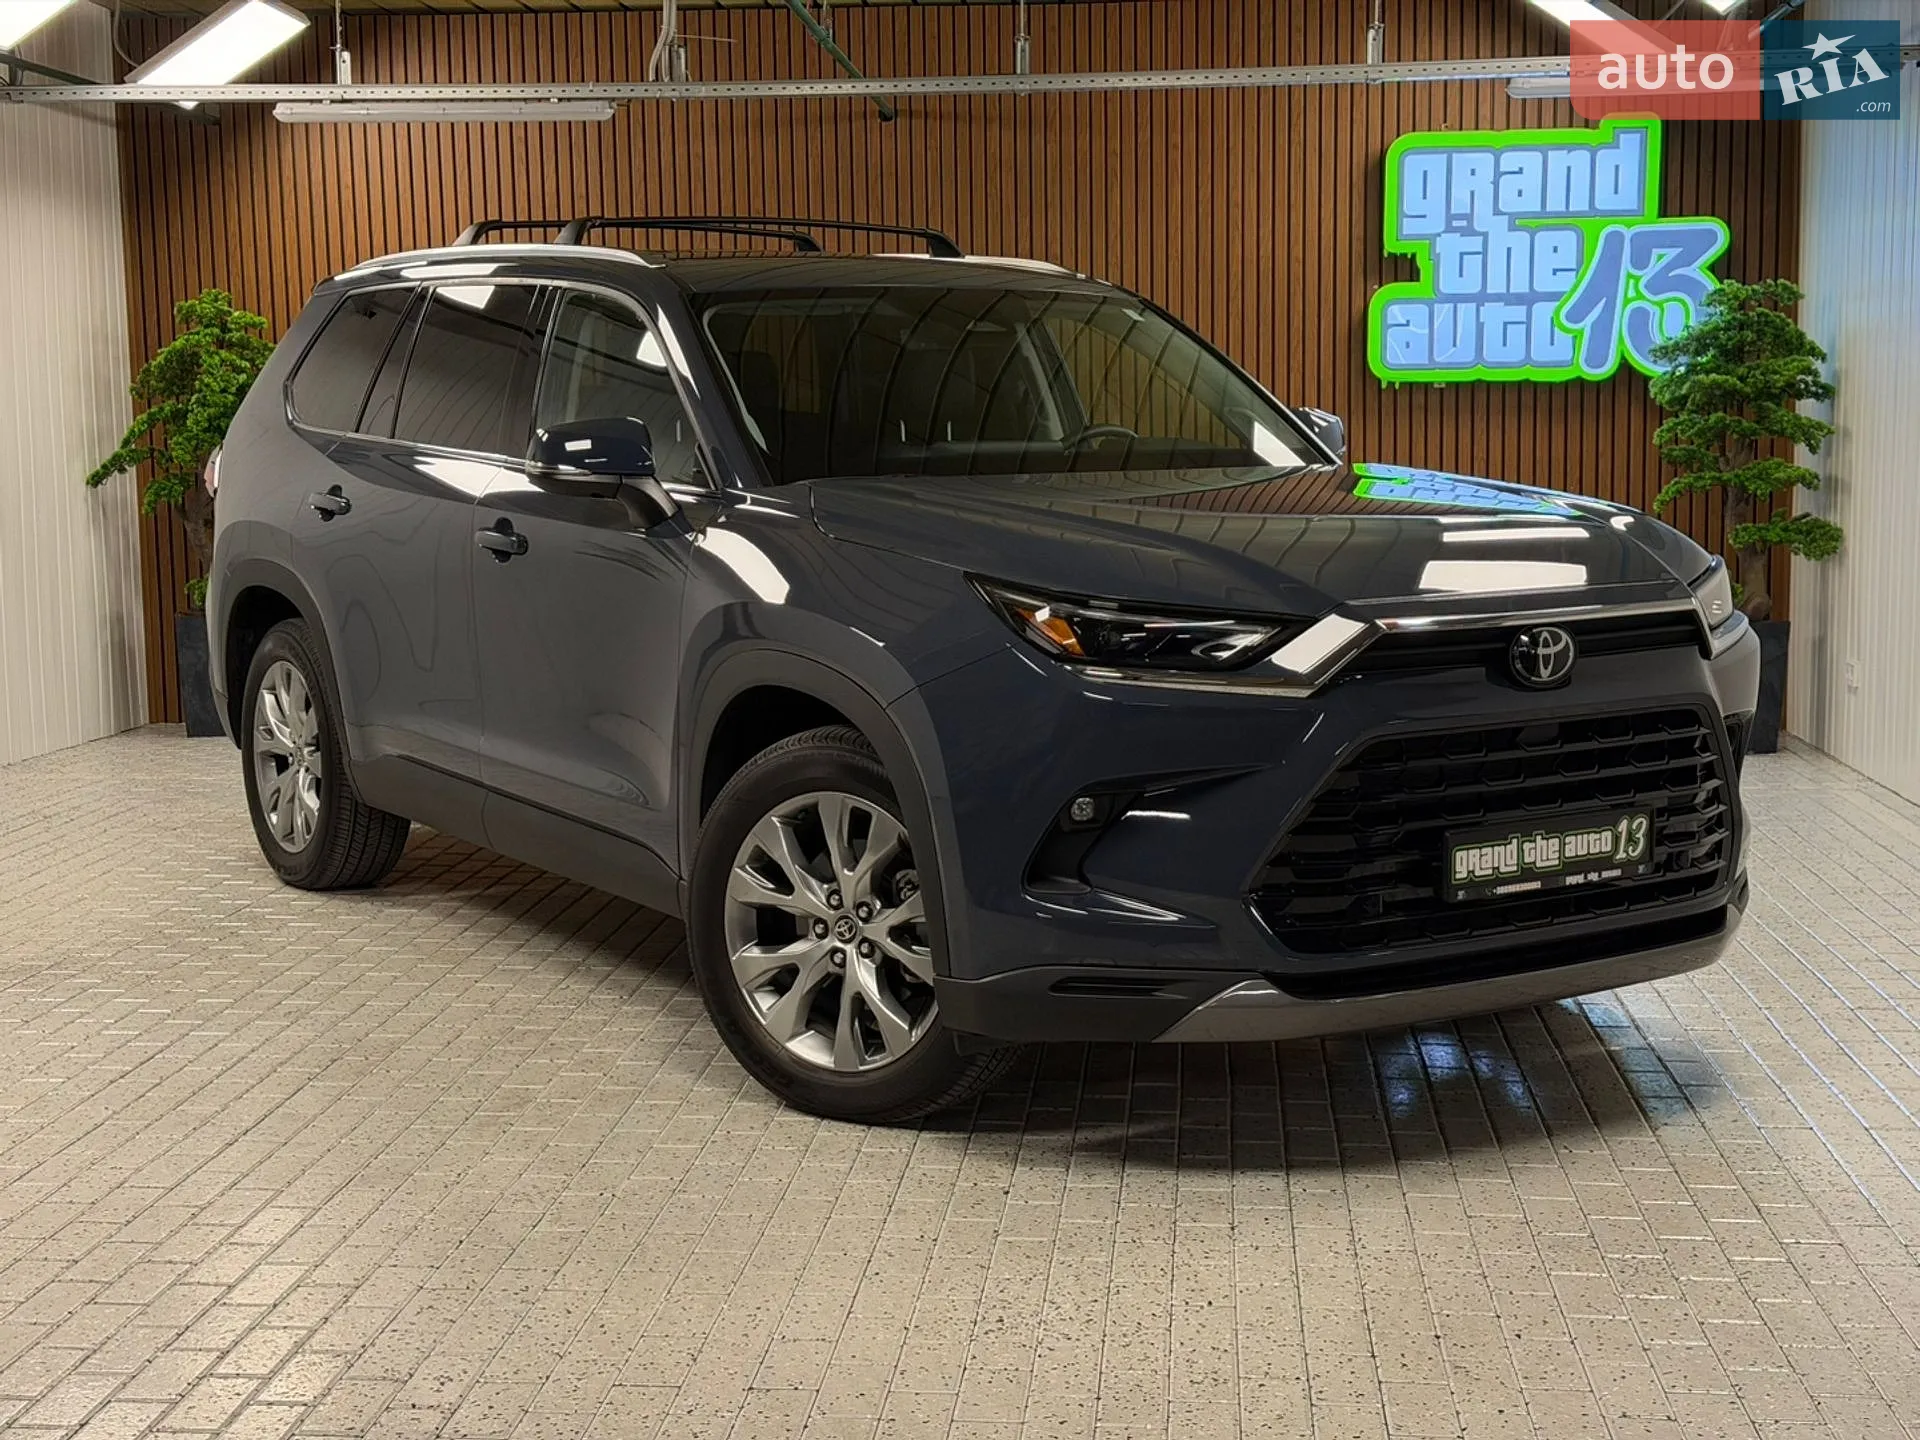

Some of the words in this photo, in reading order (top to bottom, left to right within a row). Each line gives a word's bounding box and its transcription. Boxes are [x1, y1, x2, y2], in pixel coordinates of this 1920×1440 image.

[1401, 128, 1645, 235] grand
[1385, 301, 1577, 367] auto
[1559, 222, 1726, 375] 13
[1436, 213, 1579, 295] the
[1454, 837, 1518, 880] grand
[1522, 834, 1560, 868] the
[1564, 829, 1613, 858] auto
[1614, 816, 1648, 861] 13
